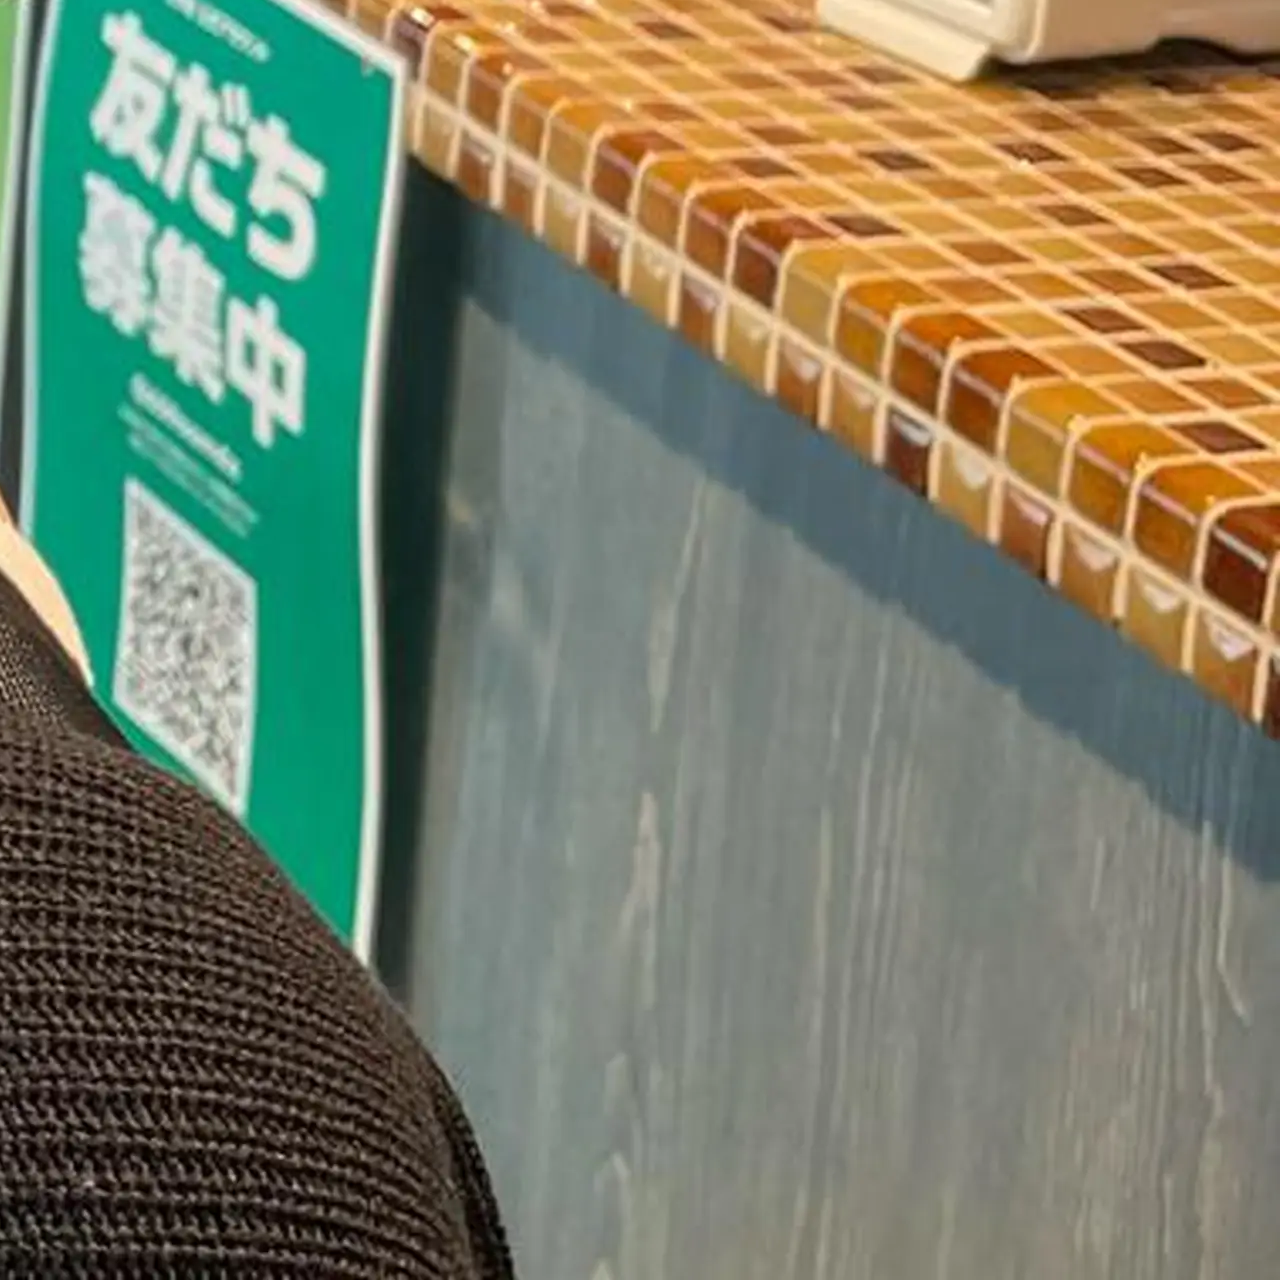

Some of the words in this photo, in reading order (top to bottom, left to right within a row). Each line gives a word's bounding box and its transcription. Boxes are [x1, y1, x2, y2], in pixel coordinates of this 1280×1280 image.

[90, 9, 326, 282] 友だち
[79, 170, 307, 450] 募集中
